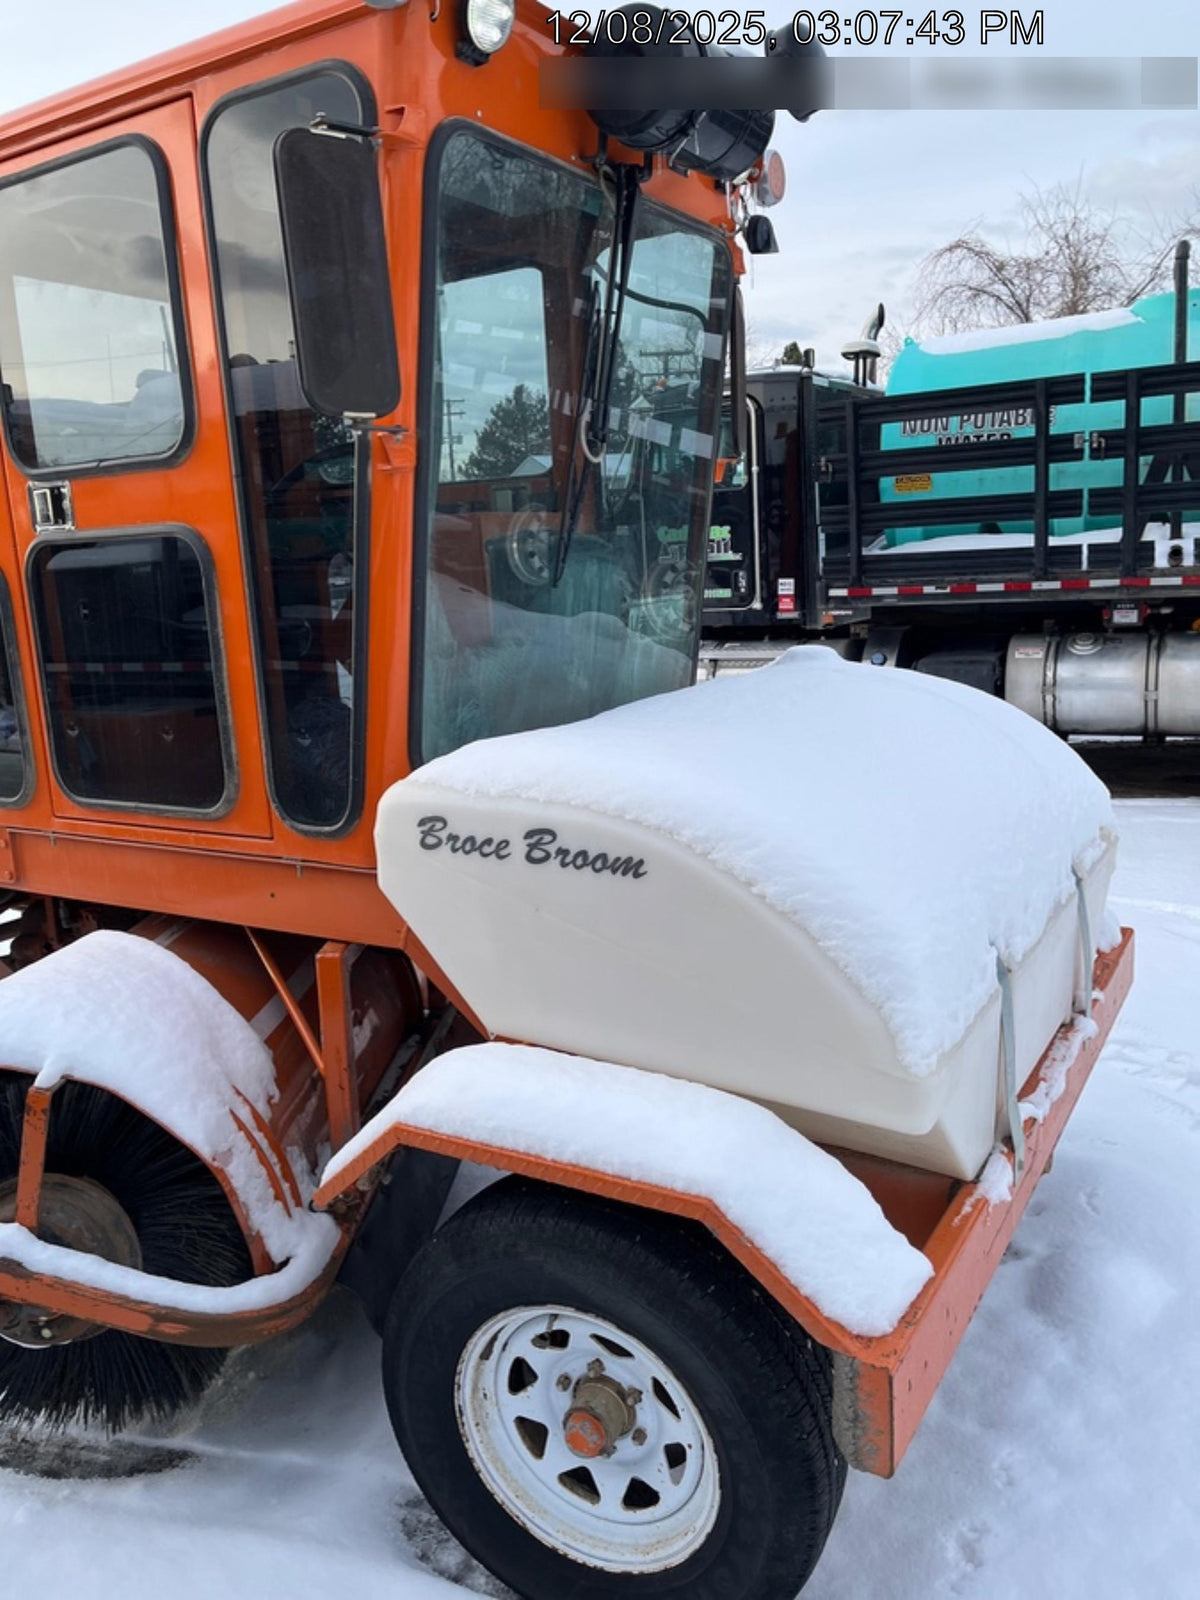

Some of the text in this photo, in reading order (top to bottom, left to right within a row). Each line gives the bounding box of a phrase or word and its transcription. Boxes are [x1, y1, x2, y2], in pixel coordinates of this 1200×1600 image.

[901, 416, 950, 437] NON
[417, 815, 648, 879] Broce Broom
